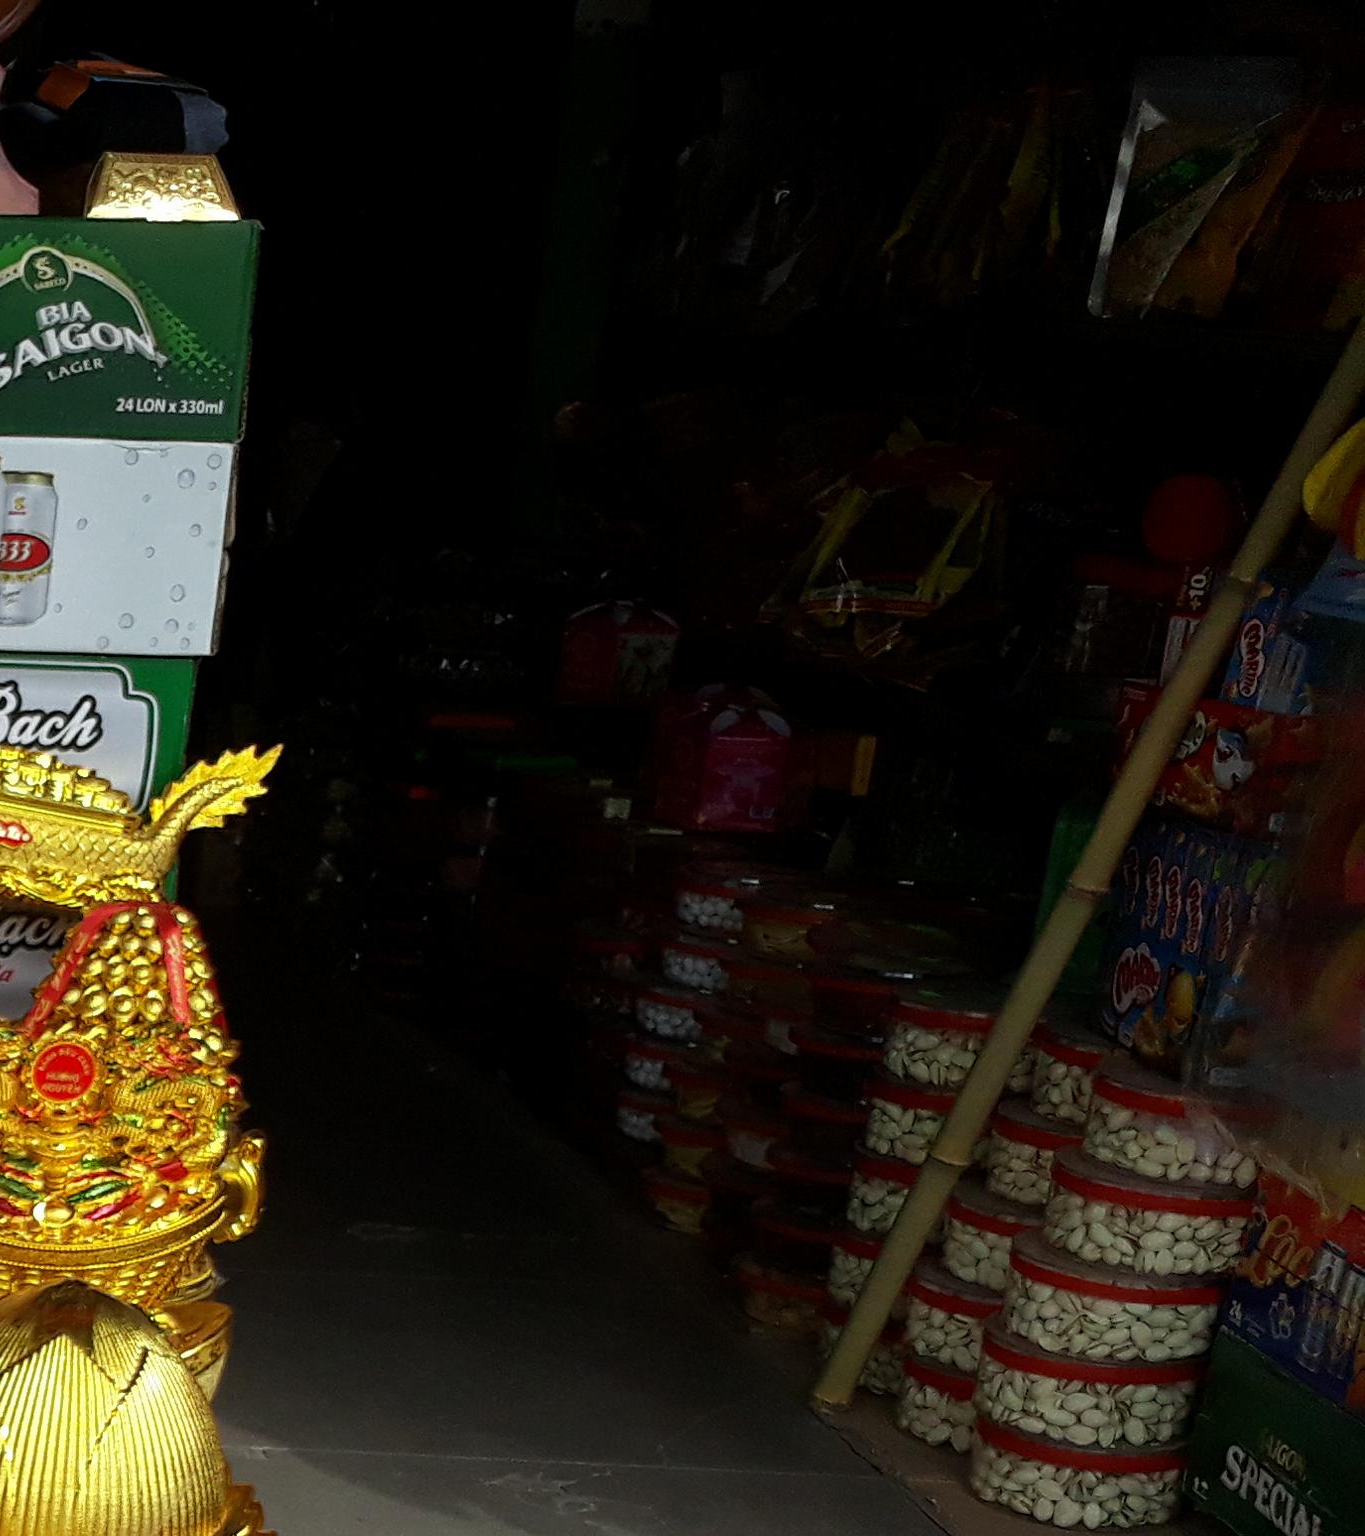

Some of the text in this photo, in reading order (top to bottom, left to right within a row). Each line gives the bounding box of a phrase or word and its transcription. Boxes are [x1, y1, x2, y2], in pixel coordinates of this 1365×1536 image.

[35, 301, 93, 329] BIA
[45, 357, 105, 382] LAGER
[116, 397, 226, 416] 24 LON x 330ml
